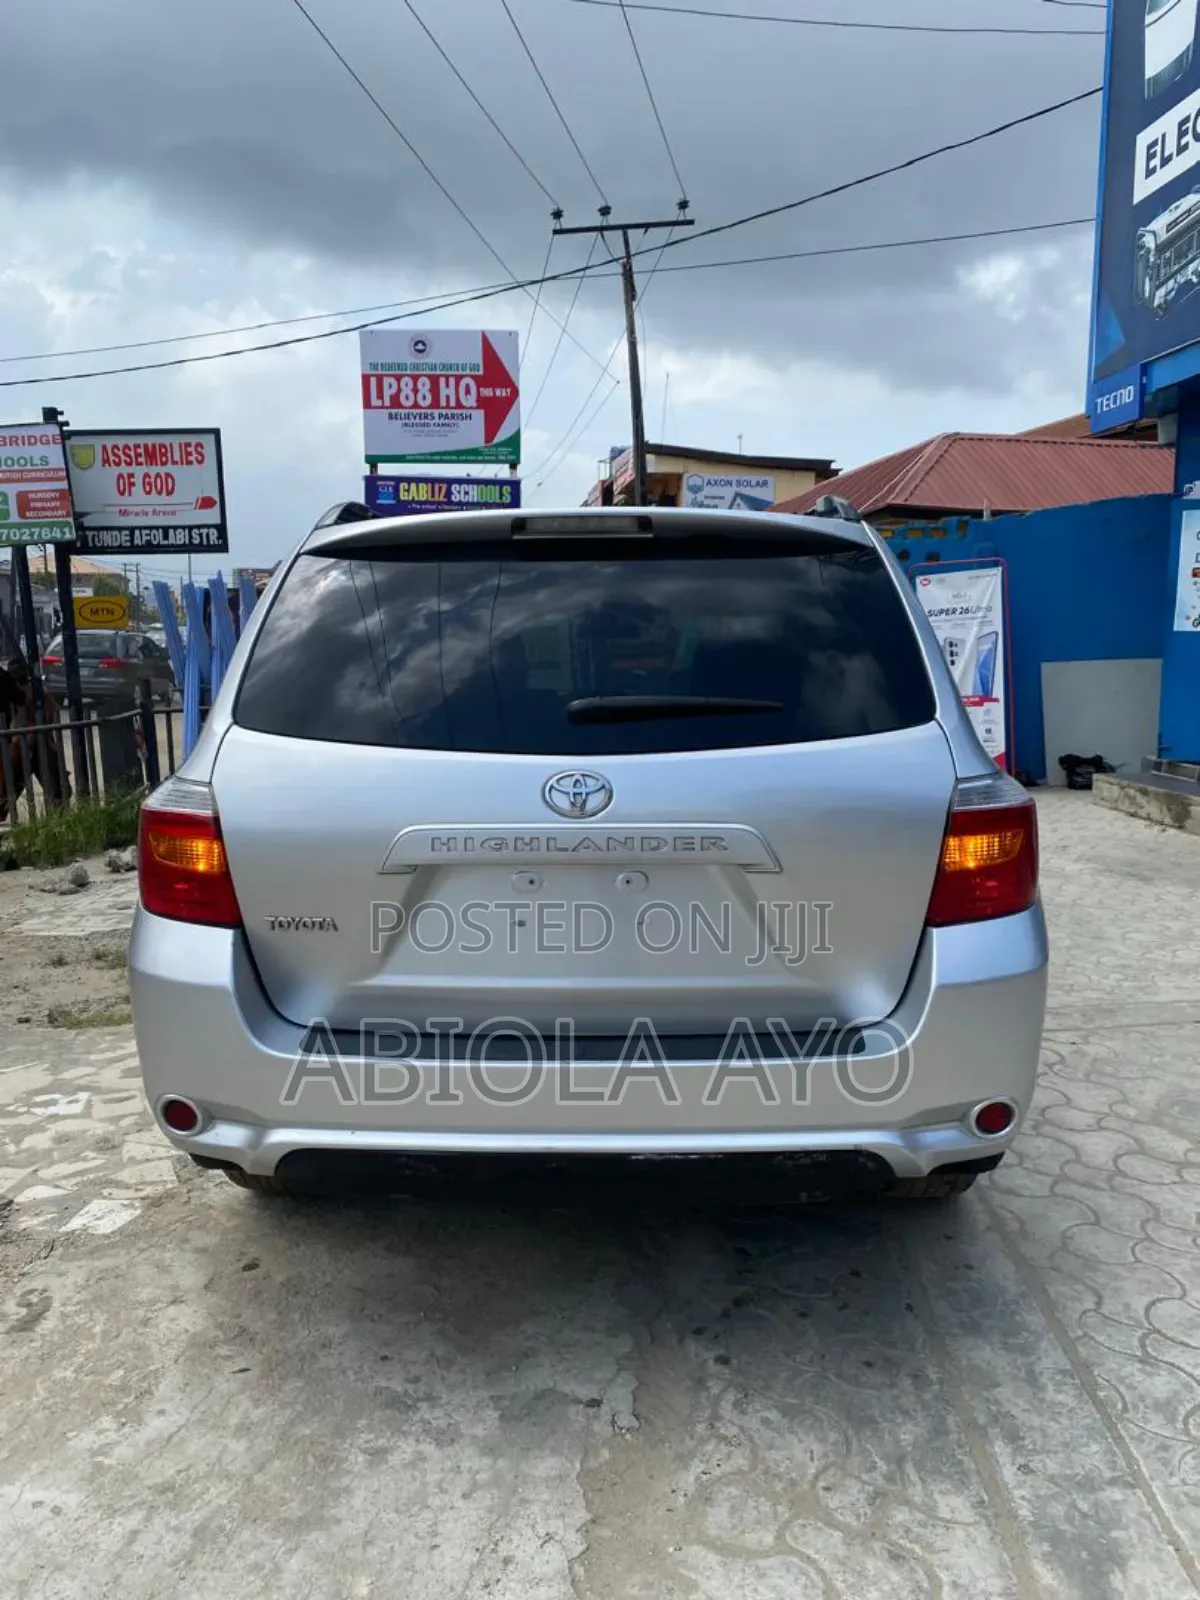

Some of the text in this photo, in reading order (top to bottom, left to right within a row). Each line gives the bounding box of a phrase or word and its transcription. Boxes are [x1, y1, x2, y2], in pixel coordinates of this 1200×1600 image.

[369, 376, 478, 408] LP88 HQ
[495, 387, 511, 397] WAY
[1095, 385, 1134, 414] TECNO
[388, 411, 472, 421] BELIEVERS PARISH
[0, 455, 49, 468] OOLS
[101, 441, 205, 468] ASSEMBLIES
[116, 472, 176, 497] OF GOD
[706, 478, 769, 488] AXON SOLAR
[400, 482, 447, 502] GABLIZ
[451, 483, 512, 503] SCHOOLS
[86, 529, 131, 547] TUNDE
[133, 527, 189, 547] AFOLABI
[191, 527, 223, 545] STR.
[90, 606, 115, 617] MTN
[927, 606, 958, 617] SUPER
[959, 605, 970, 616] 26
[430, 836, 729, 852] HIGHLANDER
[263, 915, 339, 932] TOYOTA
